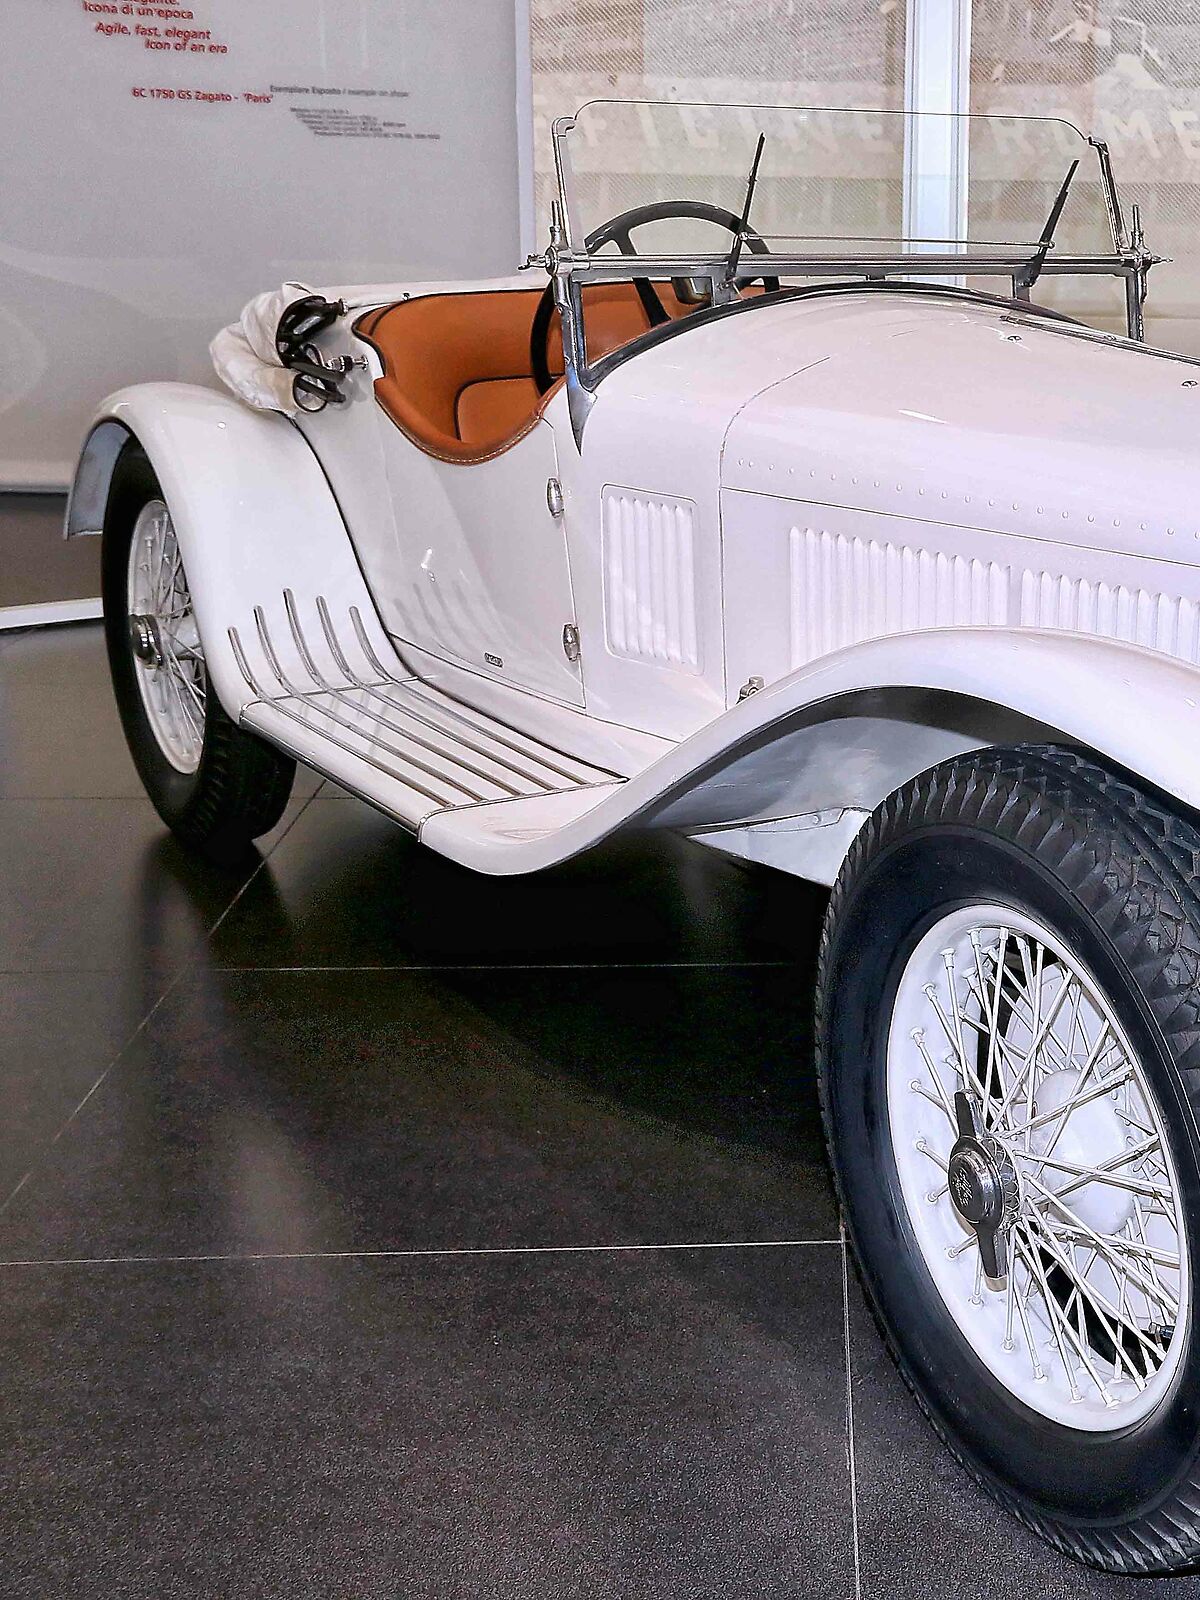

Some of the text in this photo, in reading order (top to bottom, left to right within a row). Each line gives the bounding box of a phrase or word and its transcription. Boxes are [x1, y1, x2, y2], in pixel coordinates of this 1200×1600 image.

[83, 3, 118, 14] Icona
[122, 4, 134, 15] di
[95, 22, 131, 36] Agile,
[165, 26, 212, 42] elegant
[144, 39, 228, 54] Icon of an era
[131, 87, 148, 98] 6C
[178, 89, 192, 100] GS
[195, 90, 232, 103] Zagato
